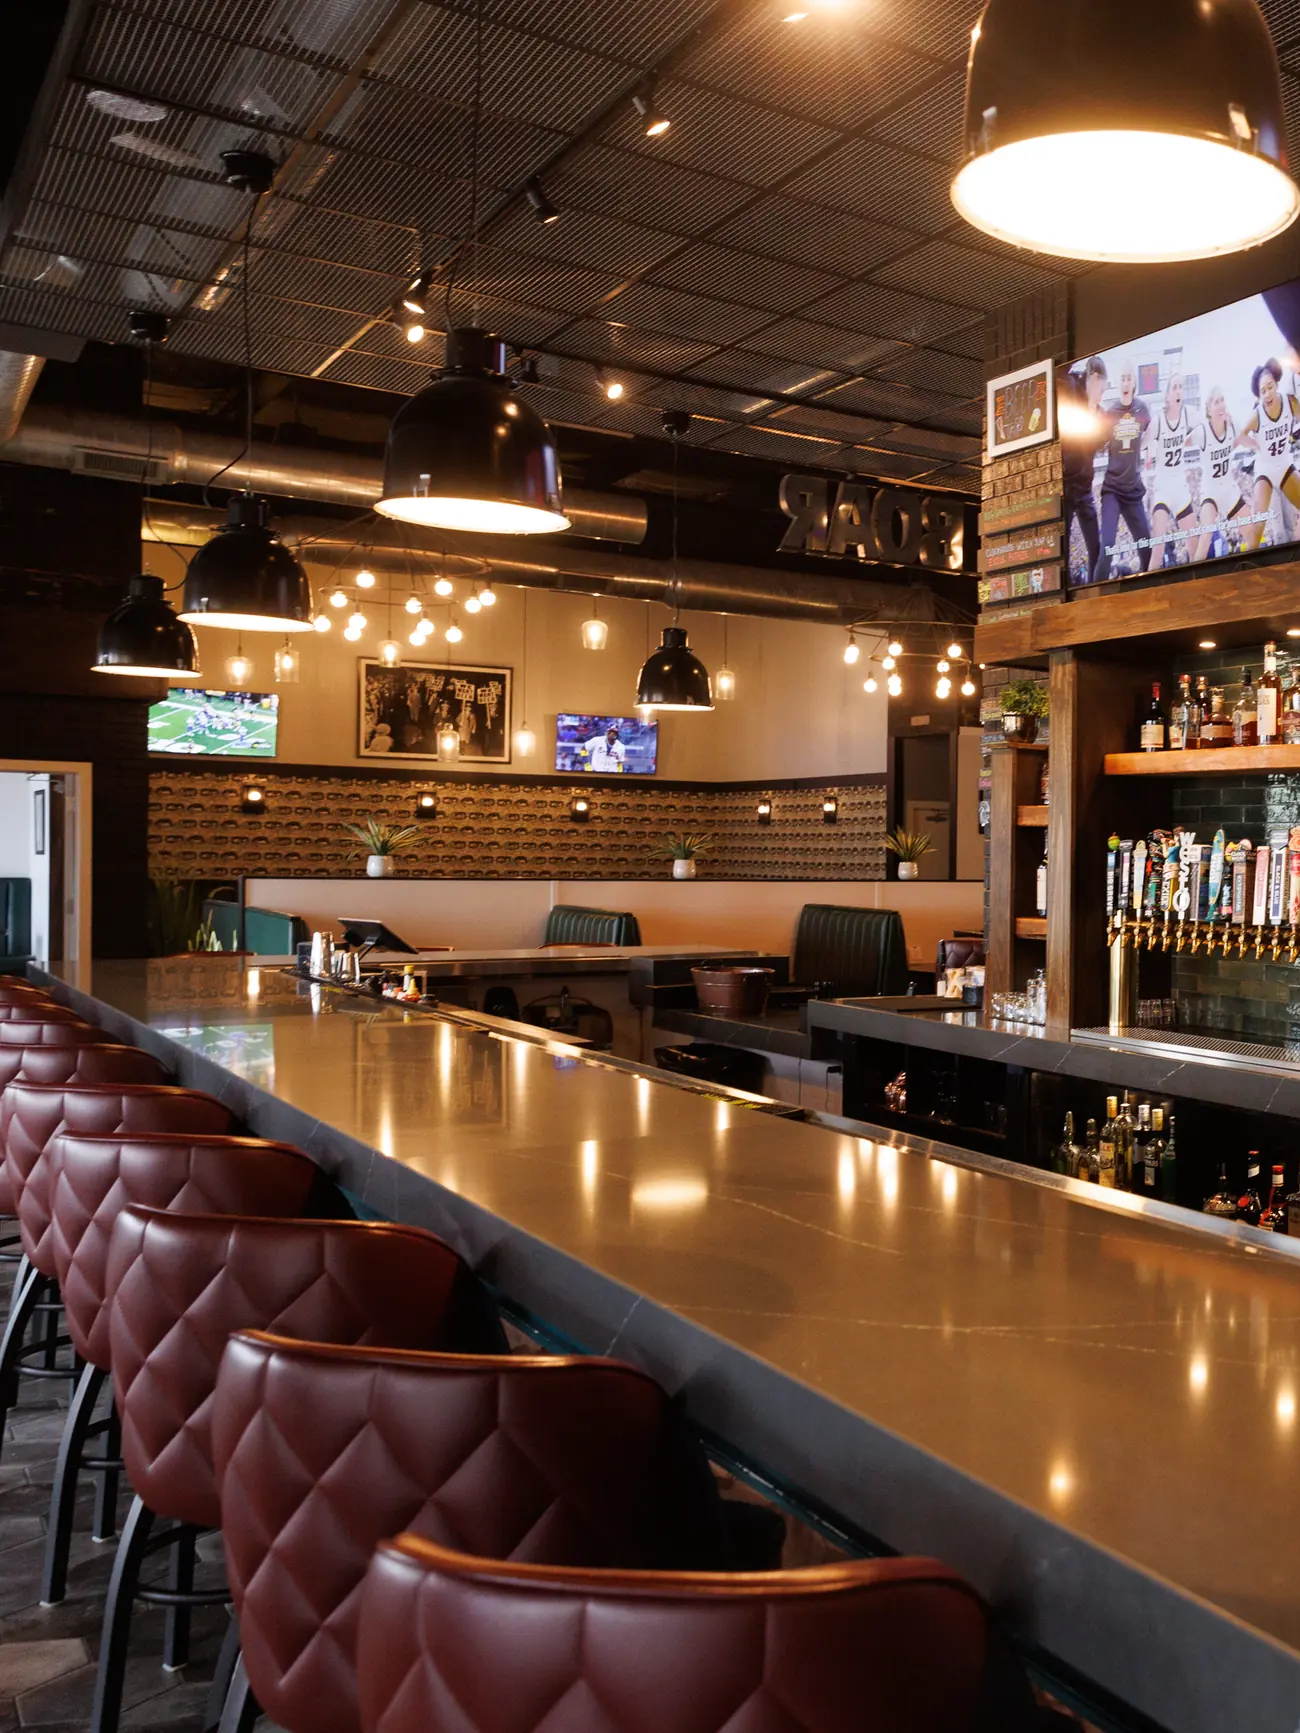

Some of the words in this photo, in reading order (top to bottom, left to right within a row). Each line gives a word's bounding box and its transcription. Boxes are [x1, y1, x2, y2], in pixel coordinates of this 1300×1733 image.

[1265, 424, 1288, 440] IOWA
[1163, 435, 1183, 448] IOWA
[1268, 437, 1287, 456] 45
[1165, 449, 1181, 467] 22
[1211, 445, 1232, 461] IOWA
[1213, 459, 1229, 478] 20
[1106, 885, 1114, 912] GROVE
[1160, 880, 1170, 906] EXILE
